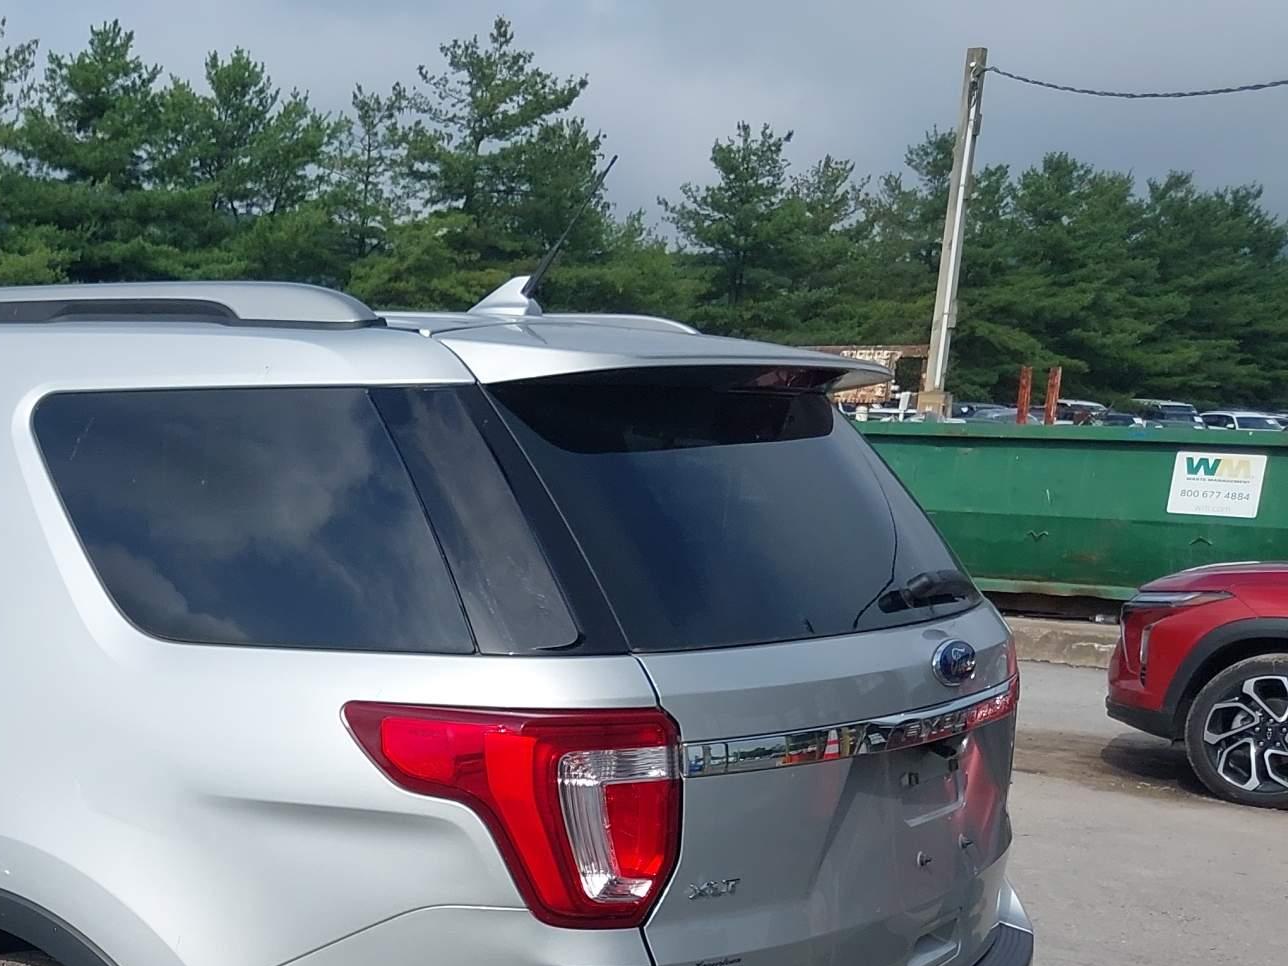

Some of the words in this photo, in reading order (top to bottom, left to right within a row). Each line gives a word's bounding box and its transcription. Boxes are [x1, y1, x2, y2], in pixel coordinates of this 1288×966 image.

[1186, 456, 1251, 480] WM
[1179, 489, 1200, 498] 800
[1202, 490, 1222, 499] 677
[688, 878, 741, 900] XLT
